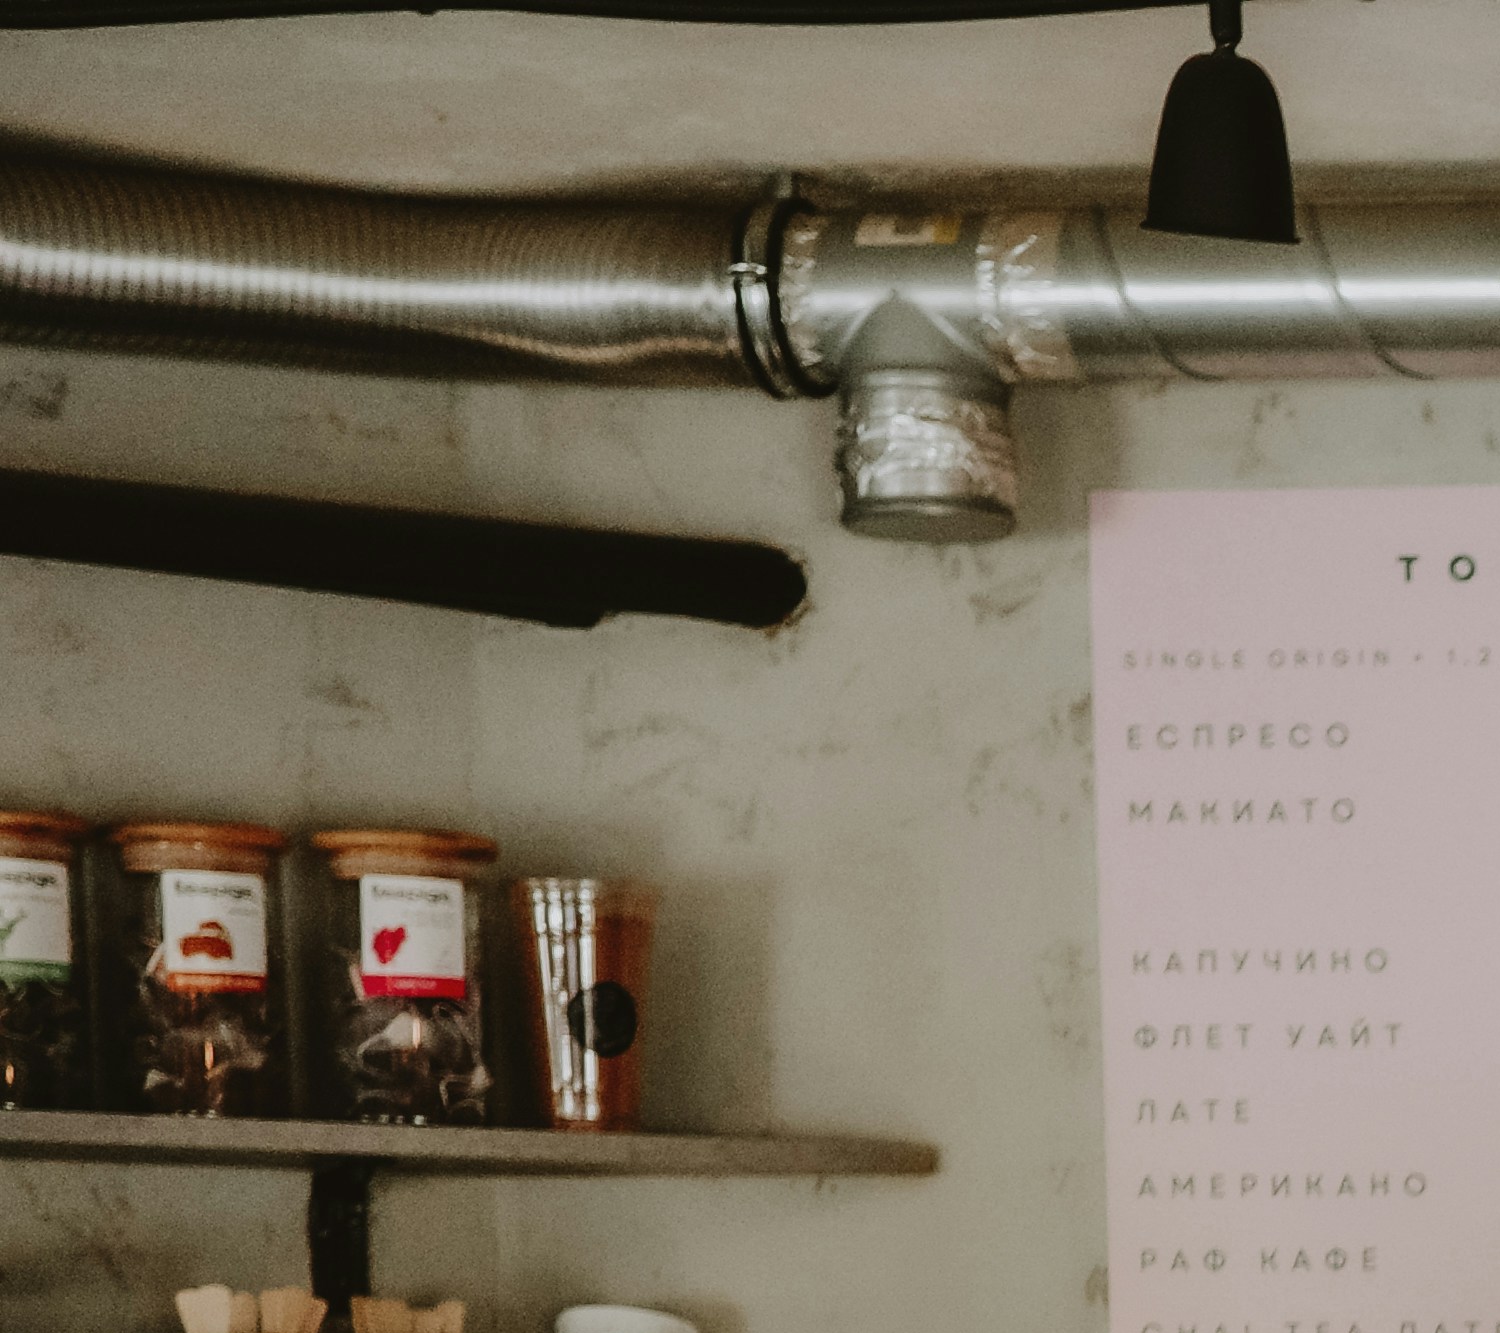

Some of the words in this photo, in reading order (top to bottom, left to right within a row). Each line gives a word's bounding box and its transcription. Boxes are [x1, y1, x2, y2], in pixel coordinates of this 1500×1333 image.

[1126, 722, 1350, 751] ЕСПРЕСО
[1128, 798, 1355, 824] МАКИАТО
[1132, 947, 1389, 974] КАПУЧИНО
[1133, 1023, 1252, 1050] ФЛЕТ
[1287, 1018, 1401, 1048] УАЙТ
[1136, 1098, 1248, 1124] ЛАТЕ
[1137, 1172, 1427, 1199] АМЕРИКАНО
[1140, 1247, 1227, 1273] РАФ
[1260, 1247, 1376, 1273] КАФЕ
